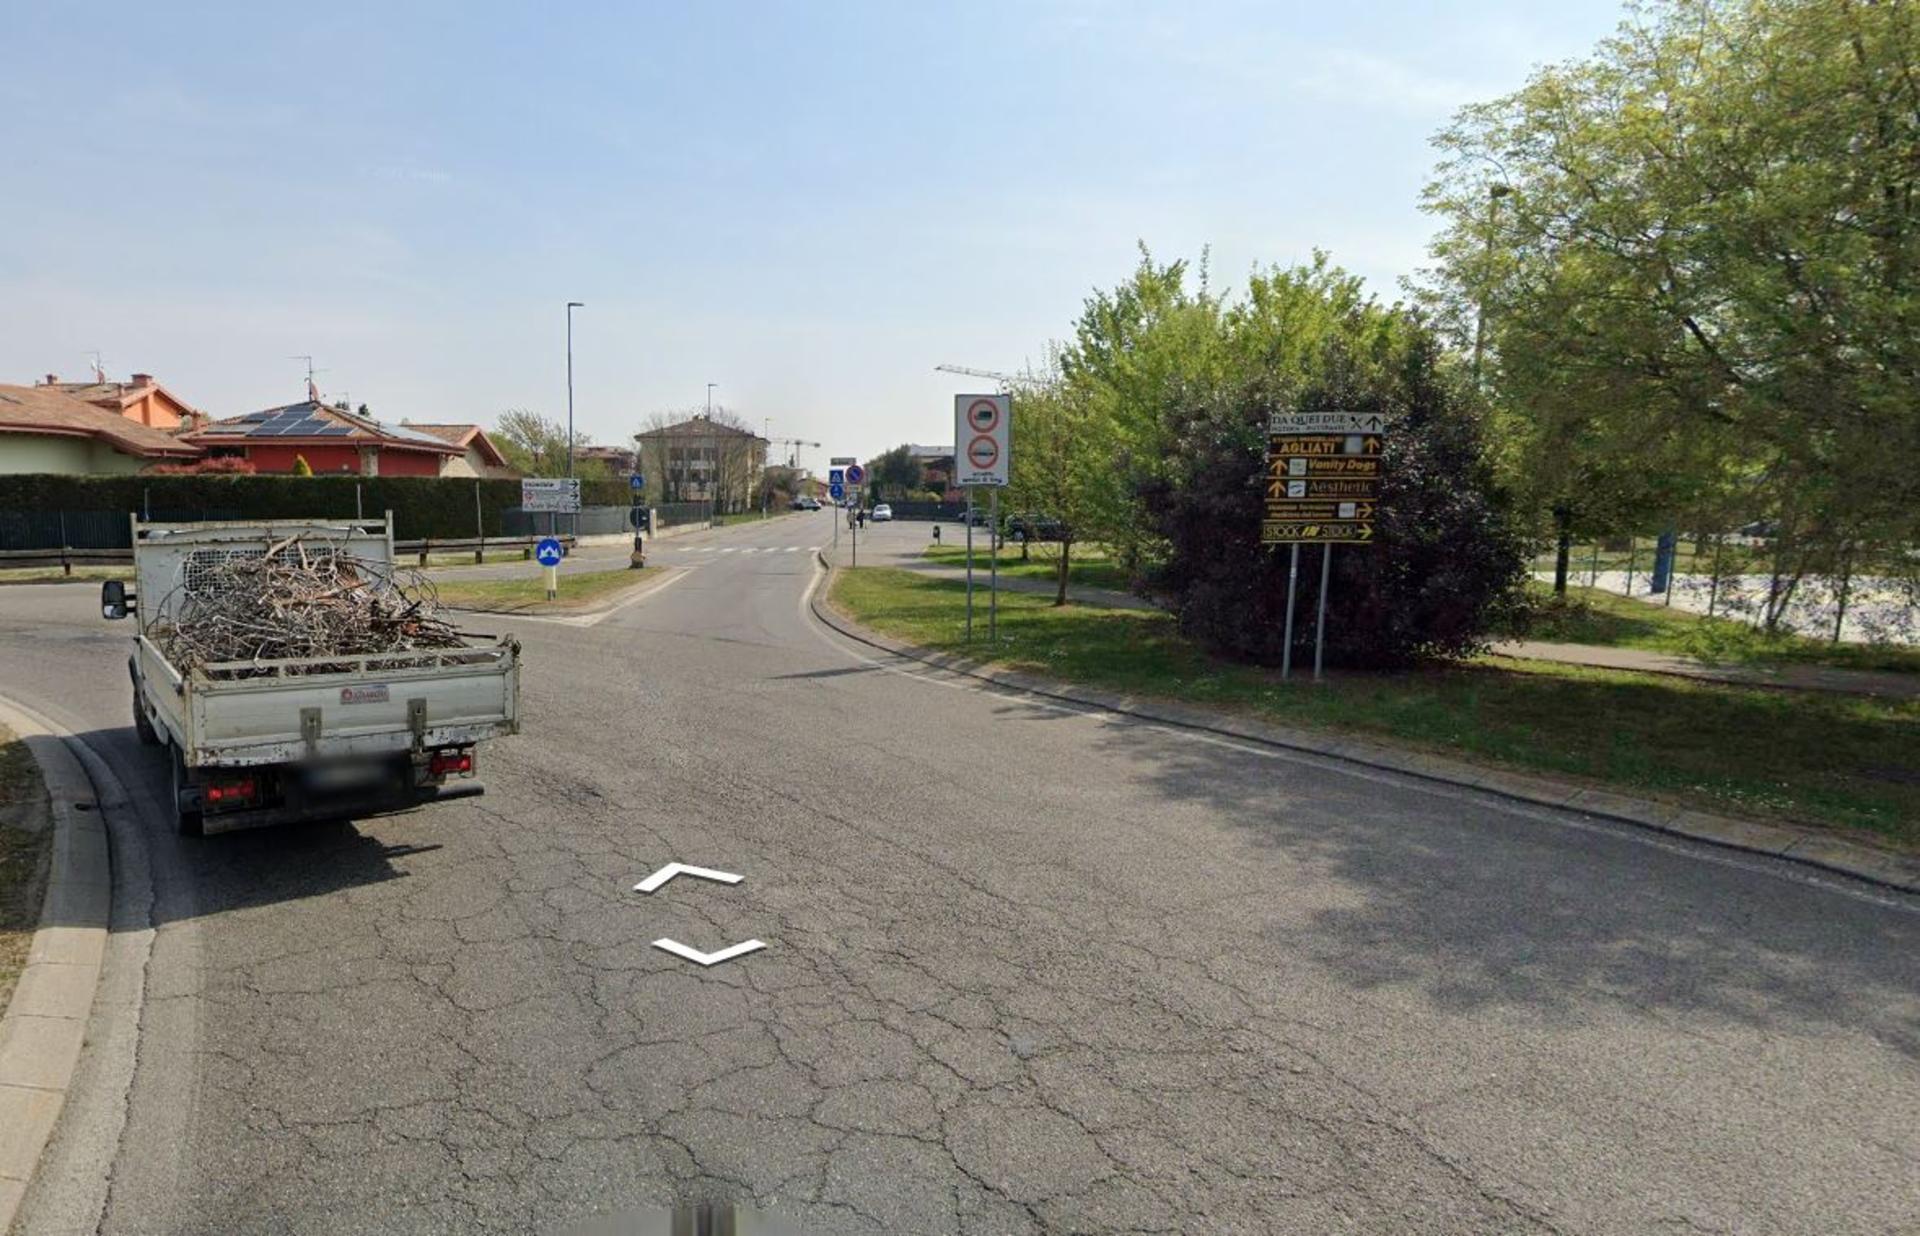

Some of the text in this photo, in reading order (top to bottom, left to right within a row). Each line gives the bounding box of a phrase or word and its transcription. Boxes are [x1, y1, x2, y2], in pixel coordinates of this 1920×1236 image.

[1272, 416, 1287, 424] DA
[1280, 442, 1335, 453] AGLIATI
[1309, 458, 1376, 472] Vanity Dogs
